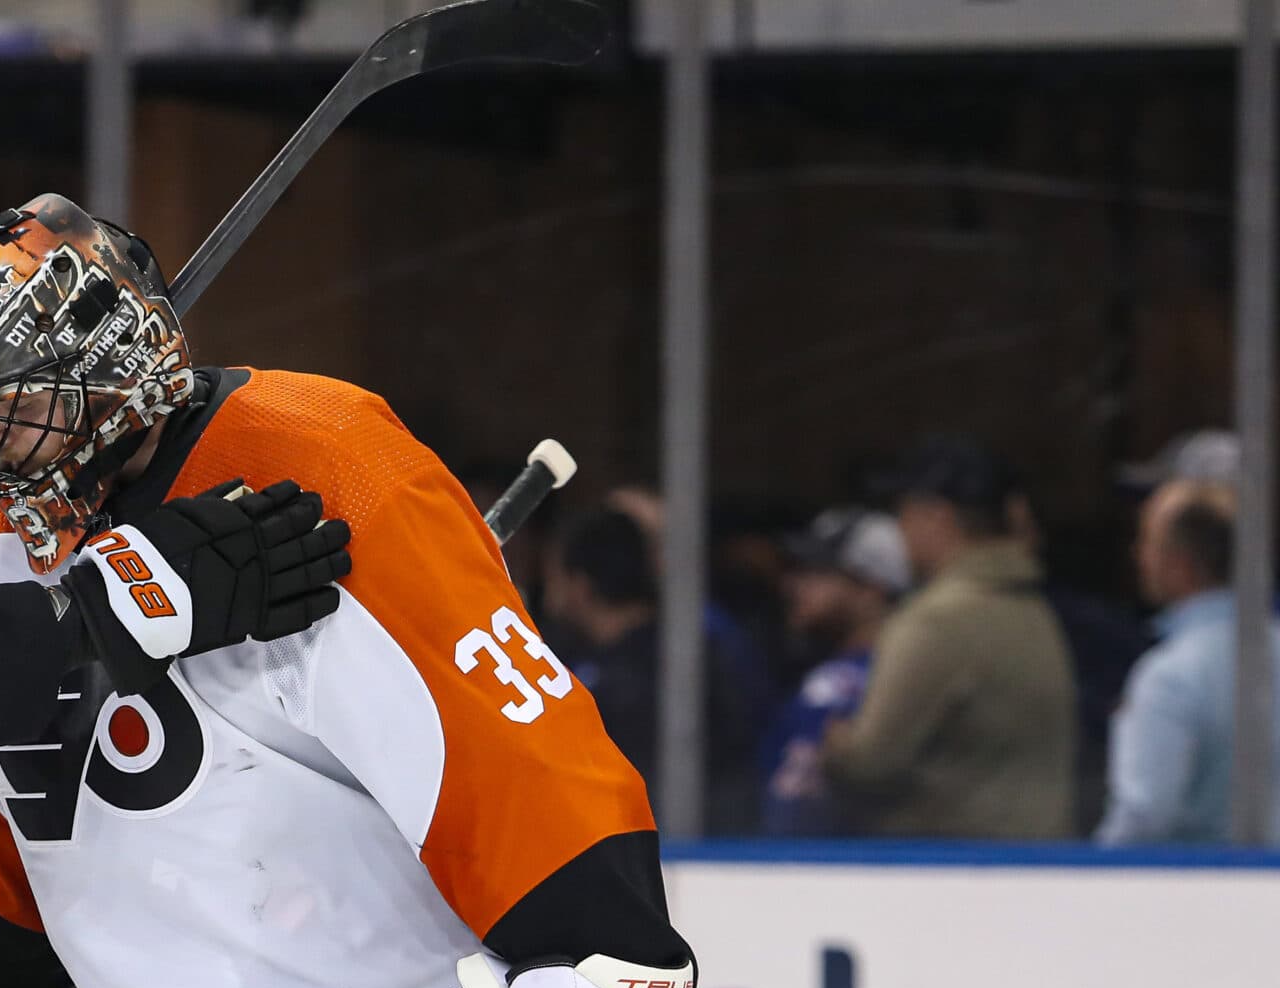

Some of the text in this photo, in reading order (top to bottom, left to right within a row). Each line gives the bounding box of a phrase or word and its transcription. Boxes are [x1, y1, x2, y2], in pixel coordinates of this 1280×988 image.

[5, 312, 37, 348] CITY
[55, 322, 78, 347] OF
[113, 339, 150, 379] LOVE
[86, 529, 178, 619] BAU
[454, 605, 573, 724] 33
